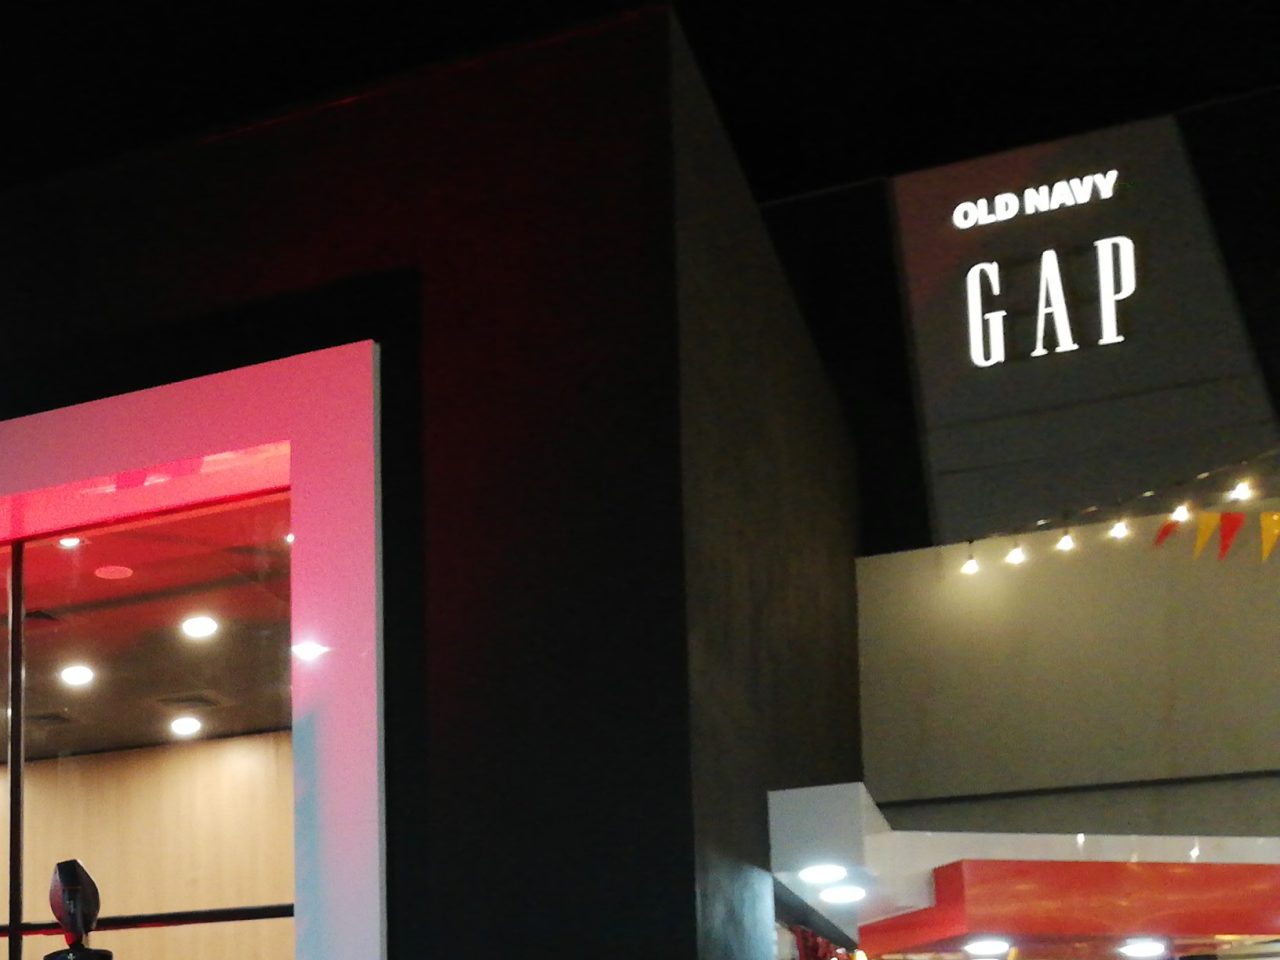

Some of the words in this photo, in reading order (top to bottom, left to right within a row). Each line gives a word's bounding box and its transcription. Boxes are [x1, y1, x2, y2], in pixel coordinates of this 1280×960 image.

[952, 191, 1020, 230] OLD
[1023, 169, 1119, 216] NAVY
[965, 234, 1137, 368] GAP
